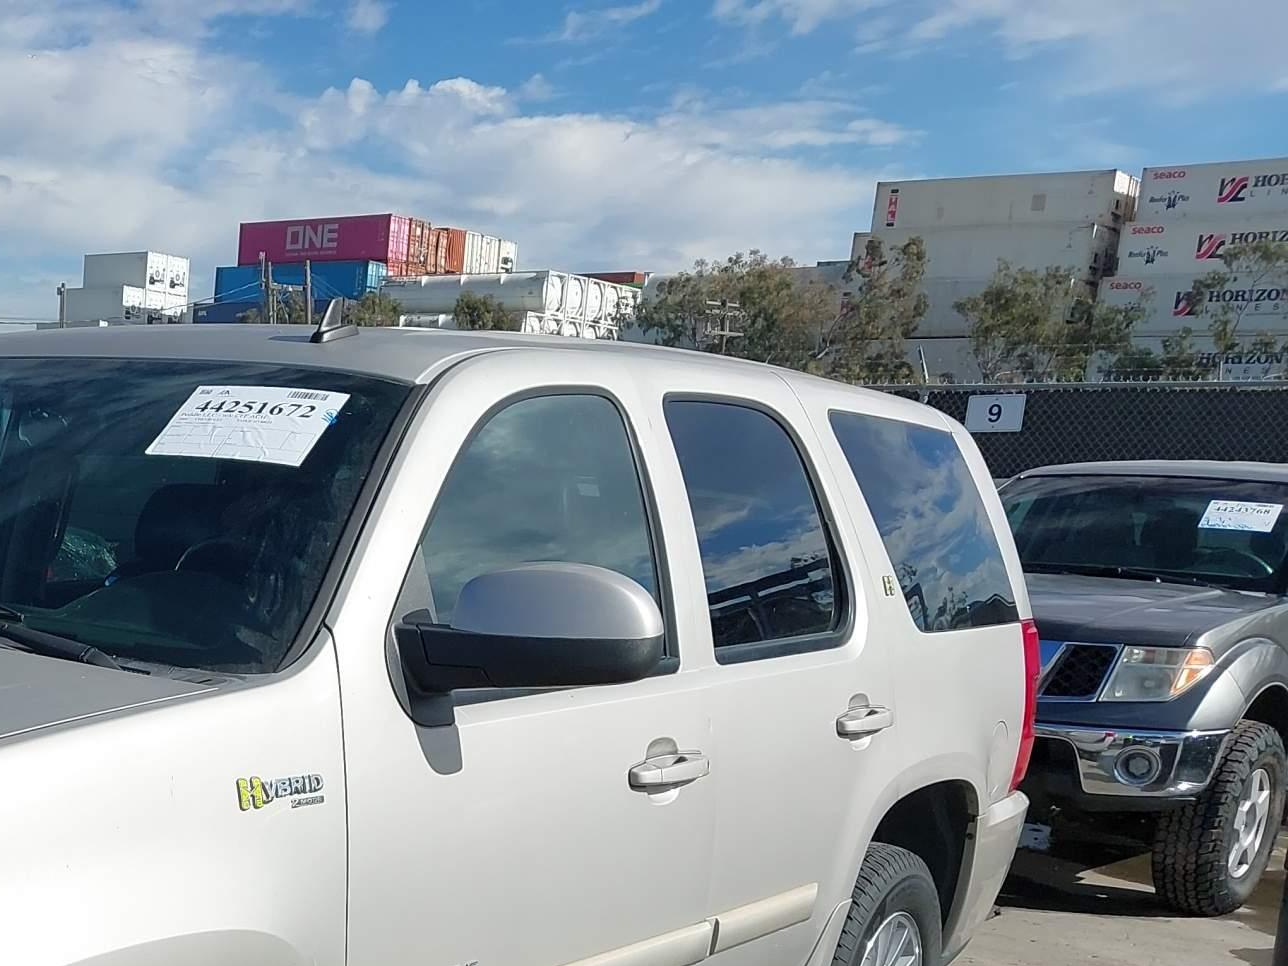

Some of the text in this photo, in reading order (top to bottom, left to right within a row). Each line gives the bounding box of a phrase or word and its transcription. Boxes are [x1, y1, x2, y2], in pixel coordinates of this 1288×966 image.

[1153, 170, 1186, 180] seaco
[285, 223, 339, 250] ONE
[1131, 226, 1165, 235] seaco
[1109, 281, 1142, 290] seaco
[195, 399, 317, 419] 44251672
[987, 403, 1003, 423] 9
